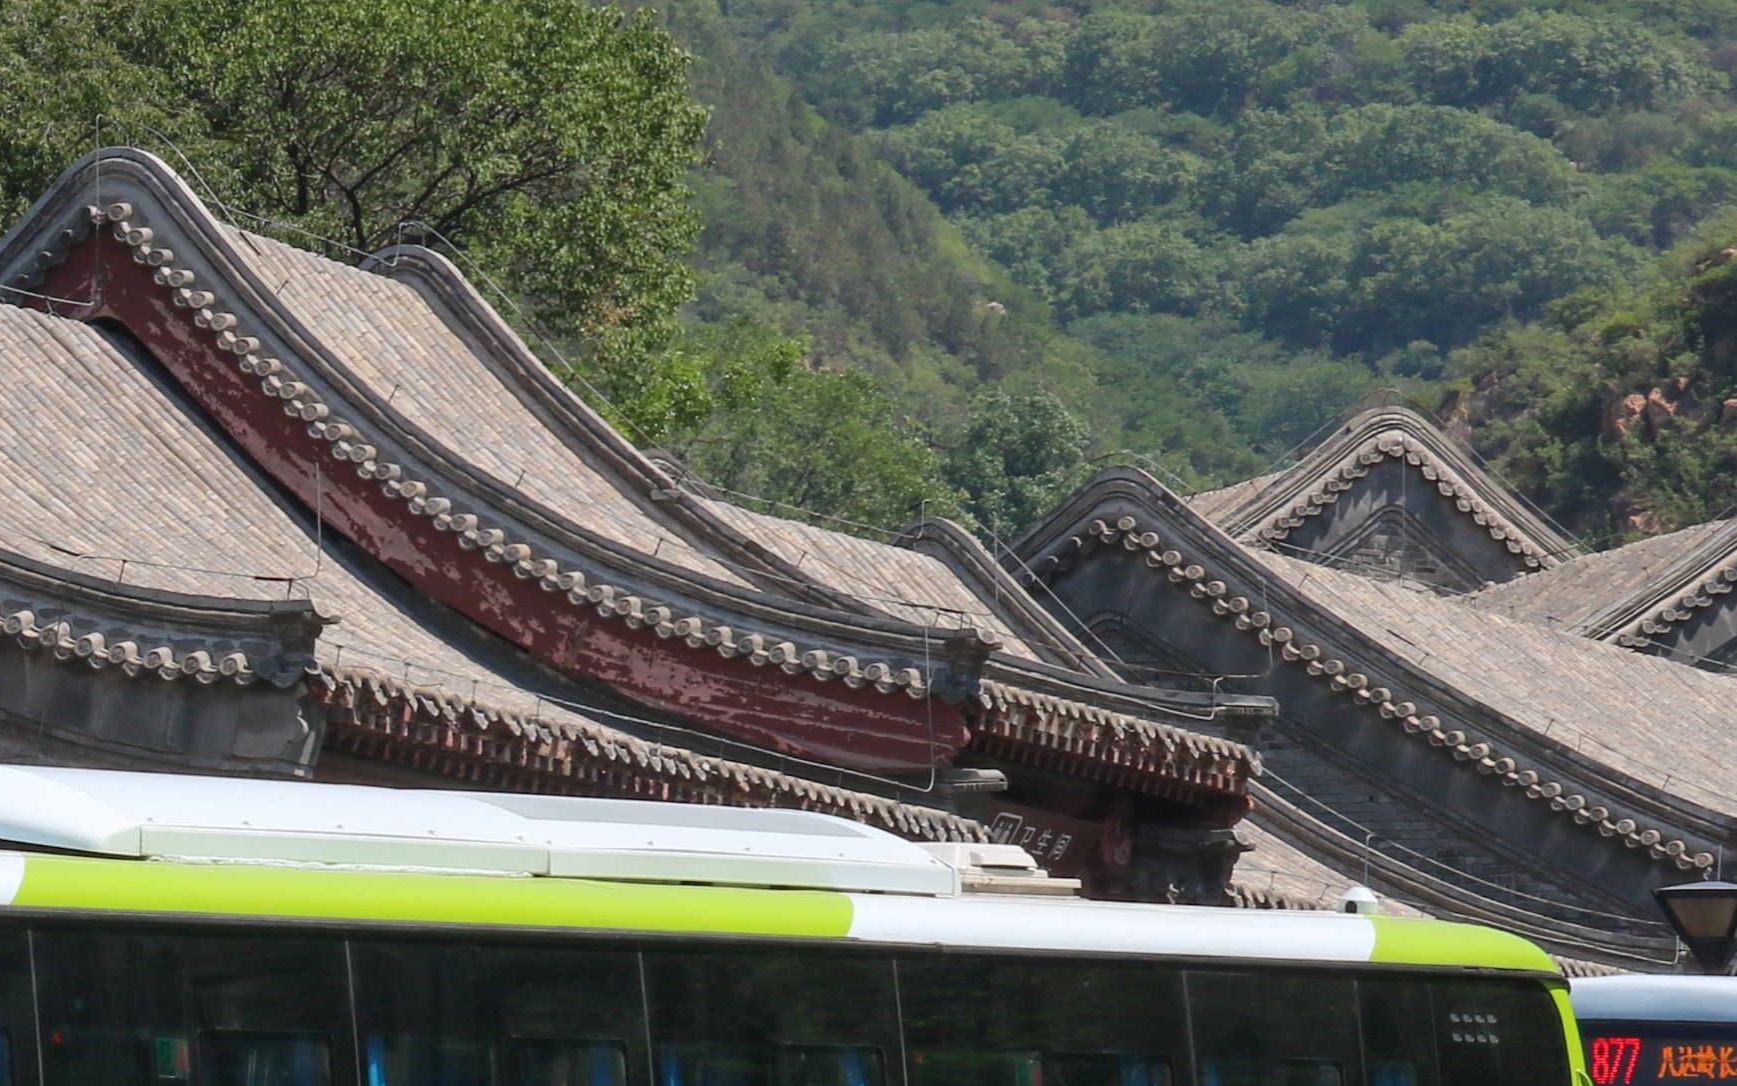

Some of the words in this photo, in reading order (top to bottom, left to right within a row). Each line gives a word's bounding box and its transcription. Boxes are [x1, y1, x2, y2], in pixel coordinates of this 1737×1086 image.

[1019, 826, 1073, 861] 卫生间
[1592, 1037, 1643, 1085] 877
